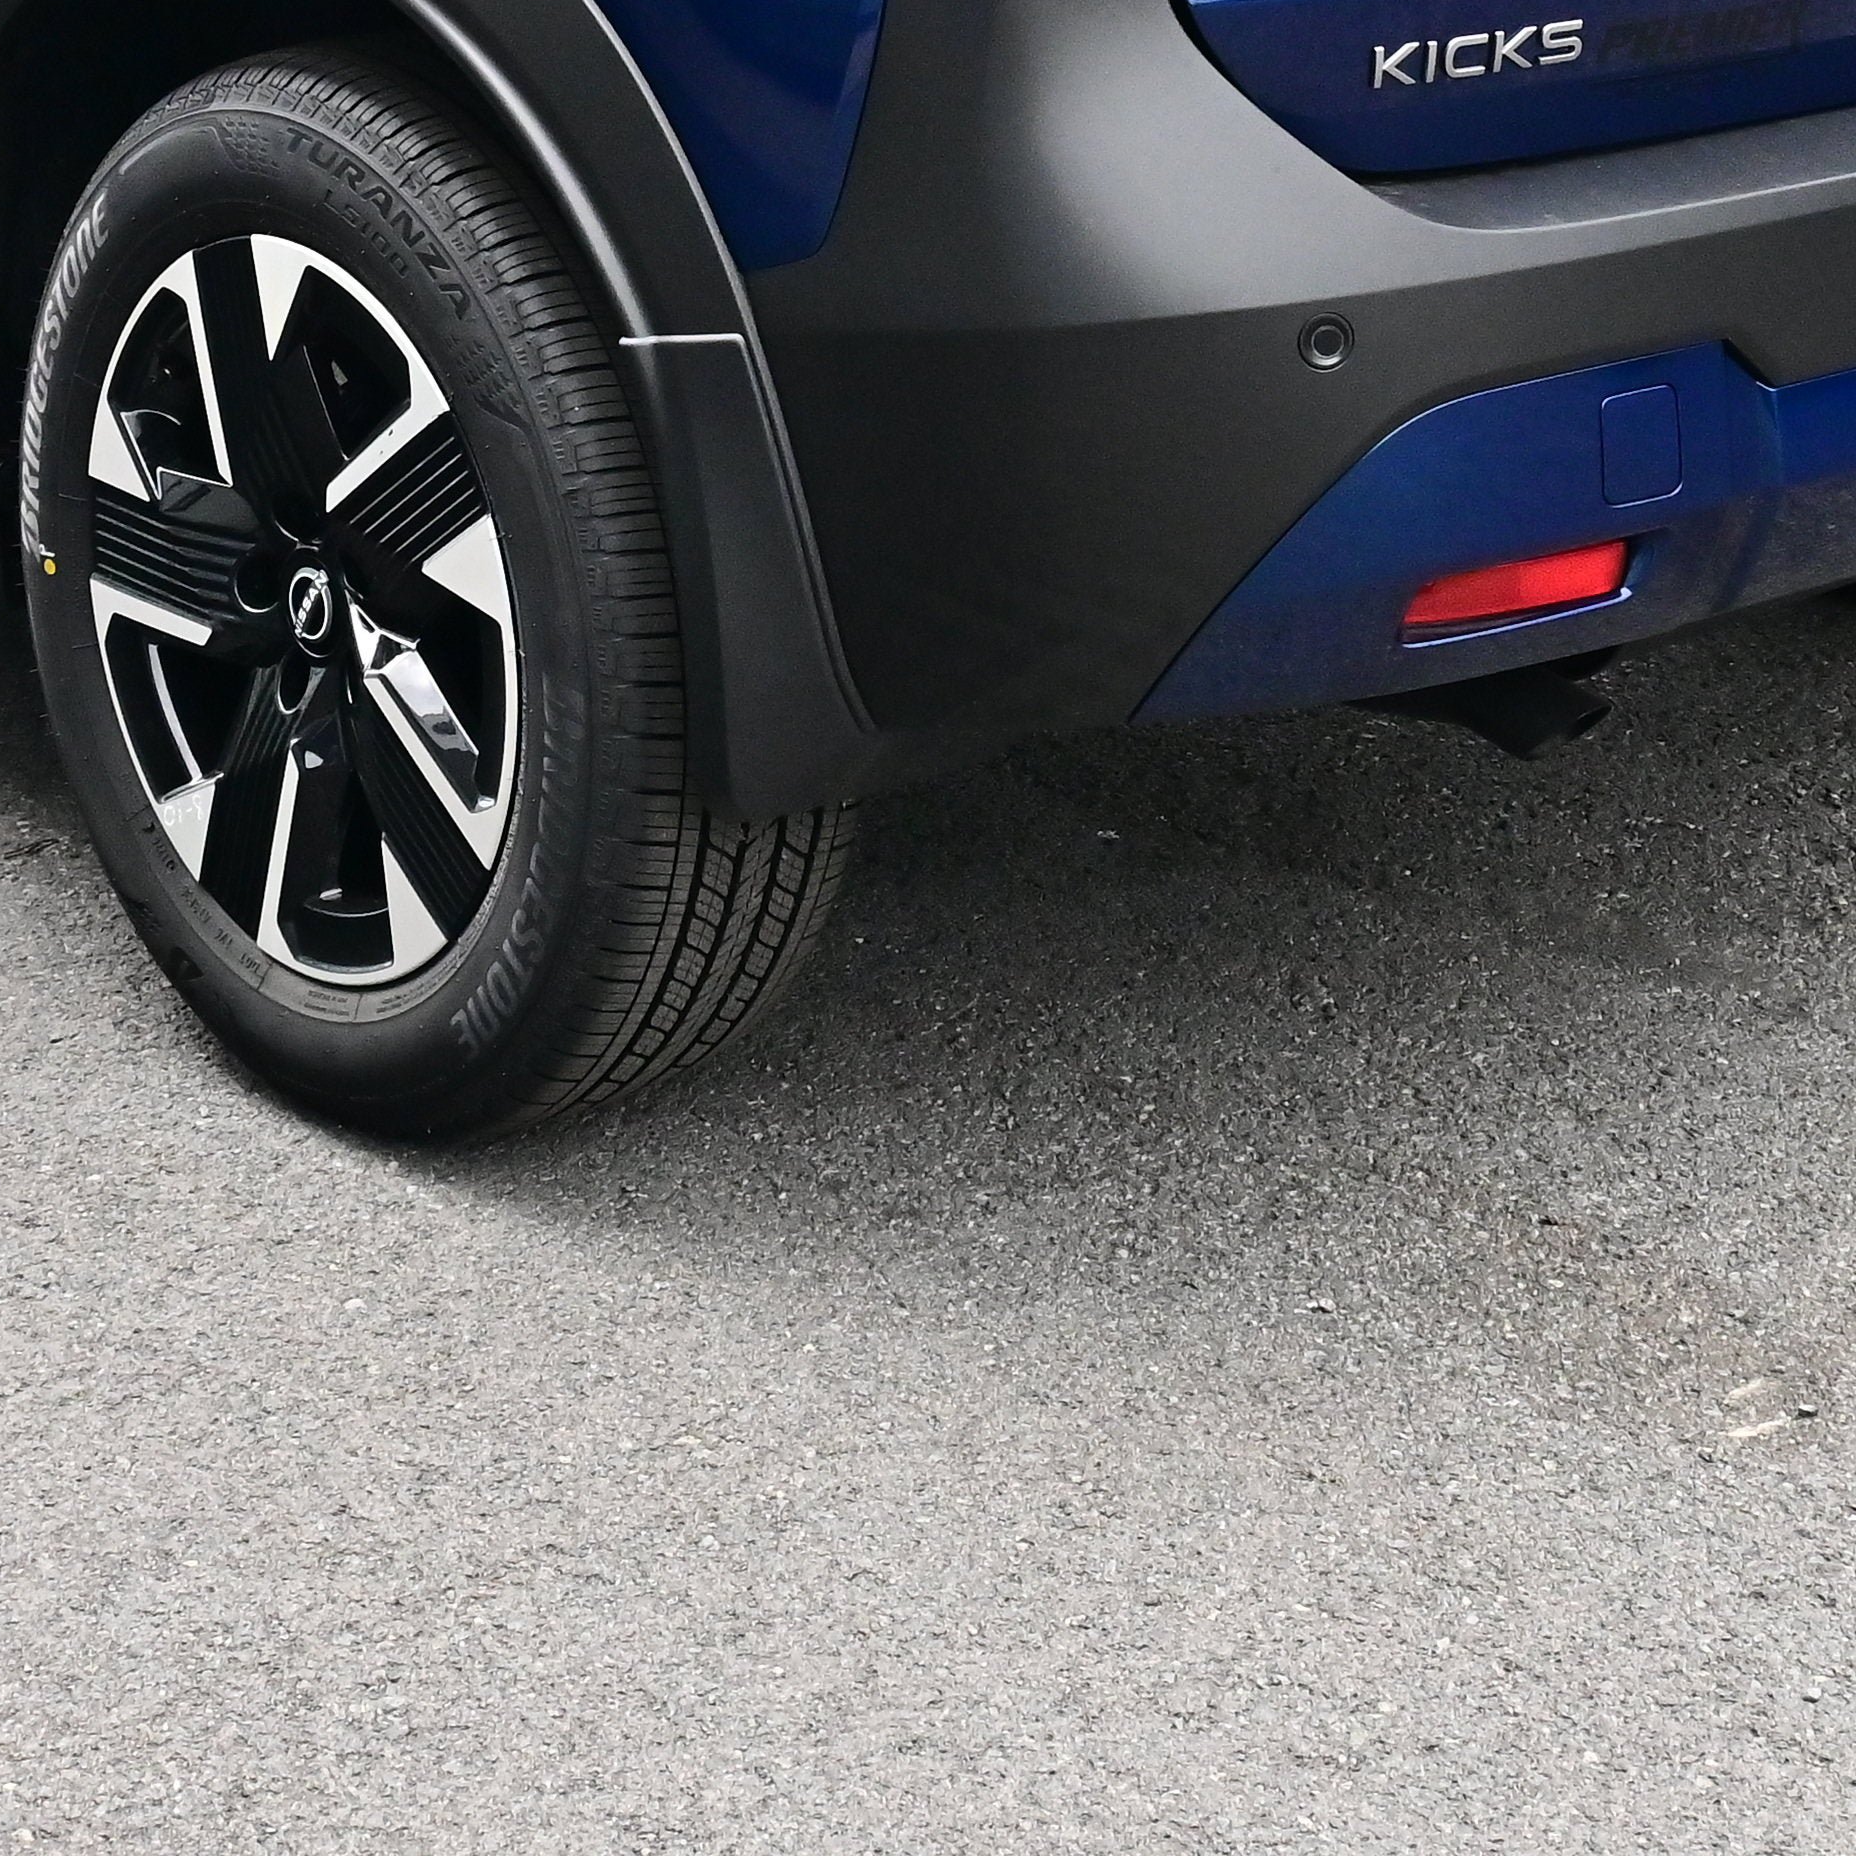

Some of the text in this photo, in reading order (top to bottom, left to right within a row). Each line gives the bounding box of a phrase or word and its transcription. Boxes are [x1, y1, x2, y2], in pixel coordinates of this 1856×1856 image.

[1373, 18, 1584, 89] KICKS
[286, 127, 471, 321] TURANZA
[20, 190, 110, 564] BRIDGESTONE
[294, 569, 330, 639] NISSAN
